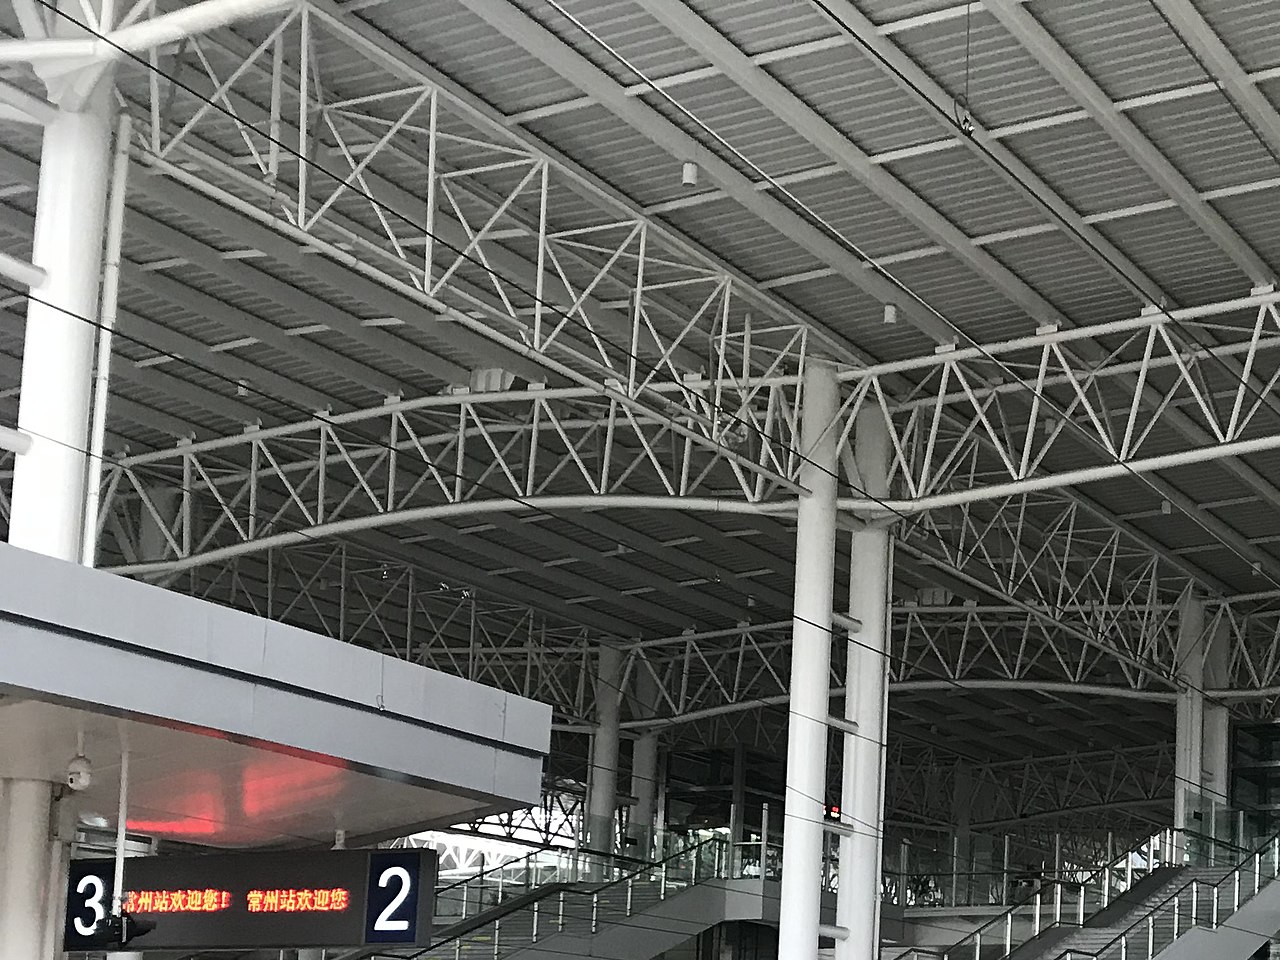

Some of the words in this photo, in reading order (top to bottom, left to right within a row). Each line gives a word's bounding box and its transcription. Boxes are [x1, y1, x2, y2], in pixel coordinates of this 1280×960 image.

[73, 874, 105, 936] 3
[246, 888, 348, 912] 常州站欢迎您
[373, 866, 411, 931] 2
